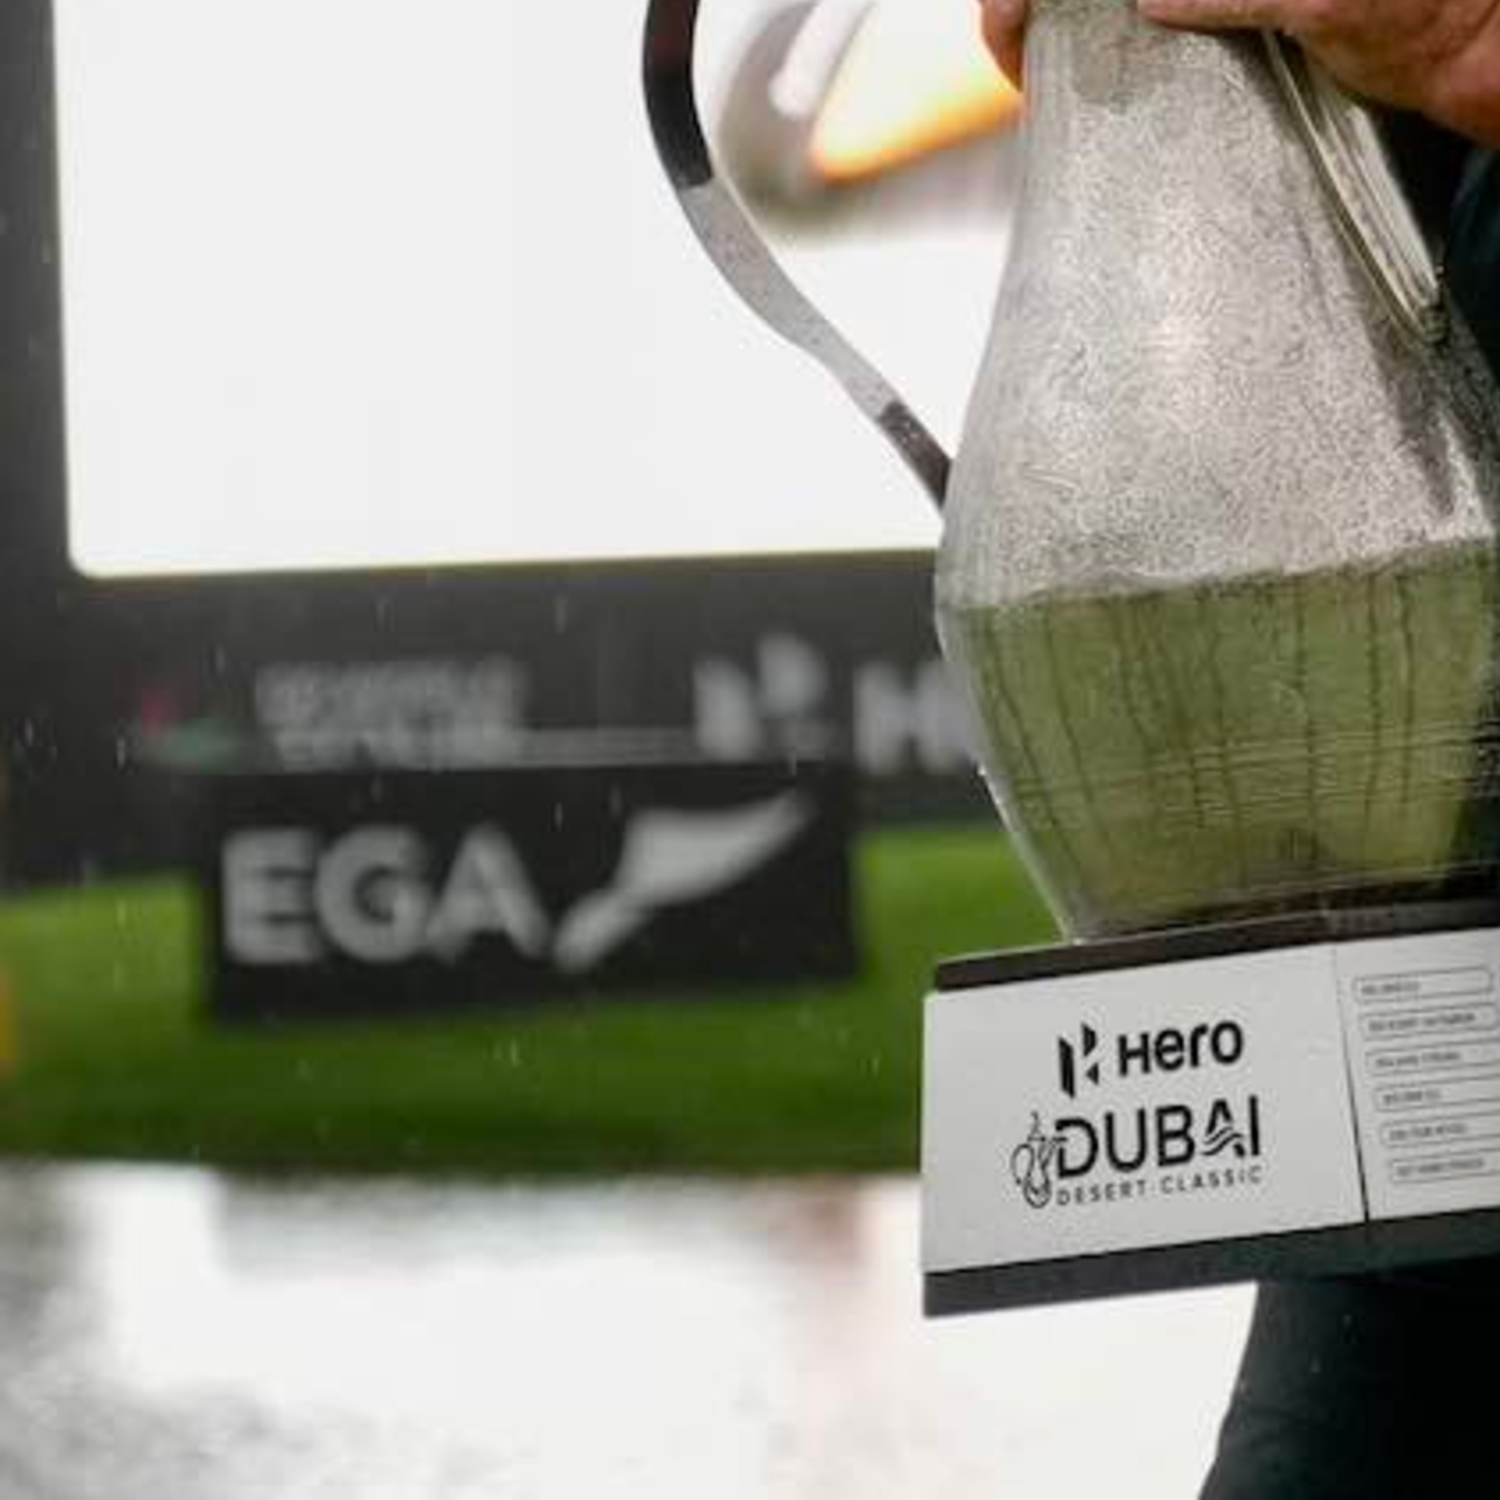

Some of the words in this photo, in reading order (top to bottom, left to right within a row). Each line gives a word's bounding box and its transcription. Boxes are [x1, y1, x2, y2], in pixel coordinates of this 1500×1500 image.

[222, 824, 554, 964] EGA
[1117, 1020, 1244, 1078] Hero
[1054, 1094, 1261, 1180] DUBAI
[1056, 1179, 1146, 1206] DESERT
[1160, 1164, 1263, 1195] CLASSIC
